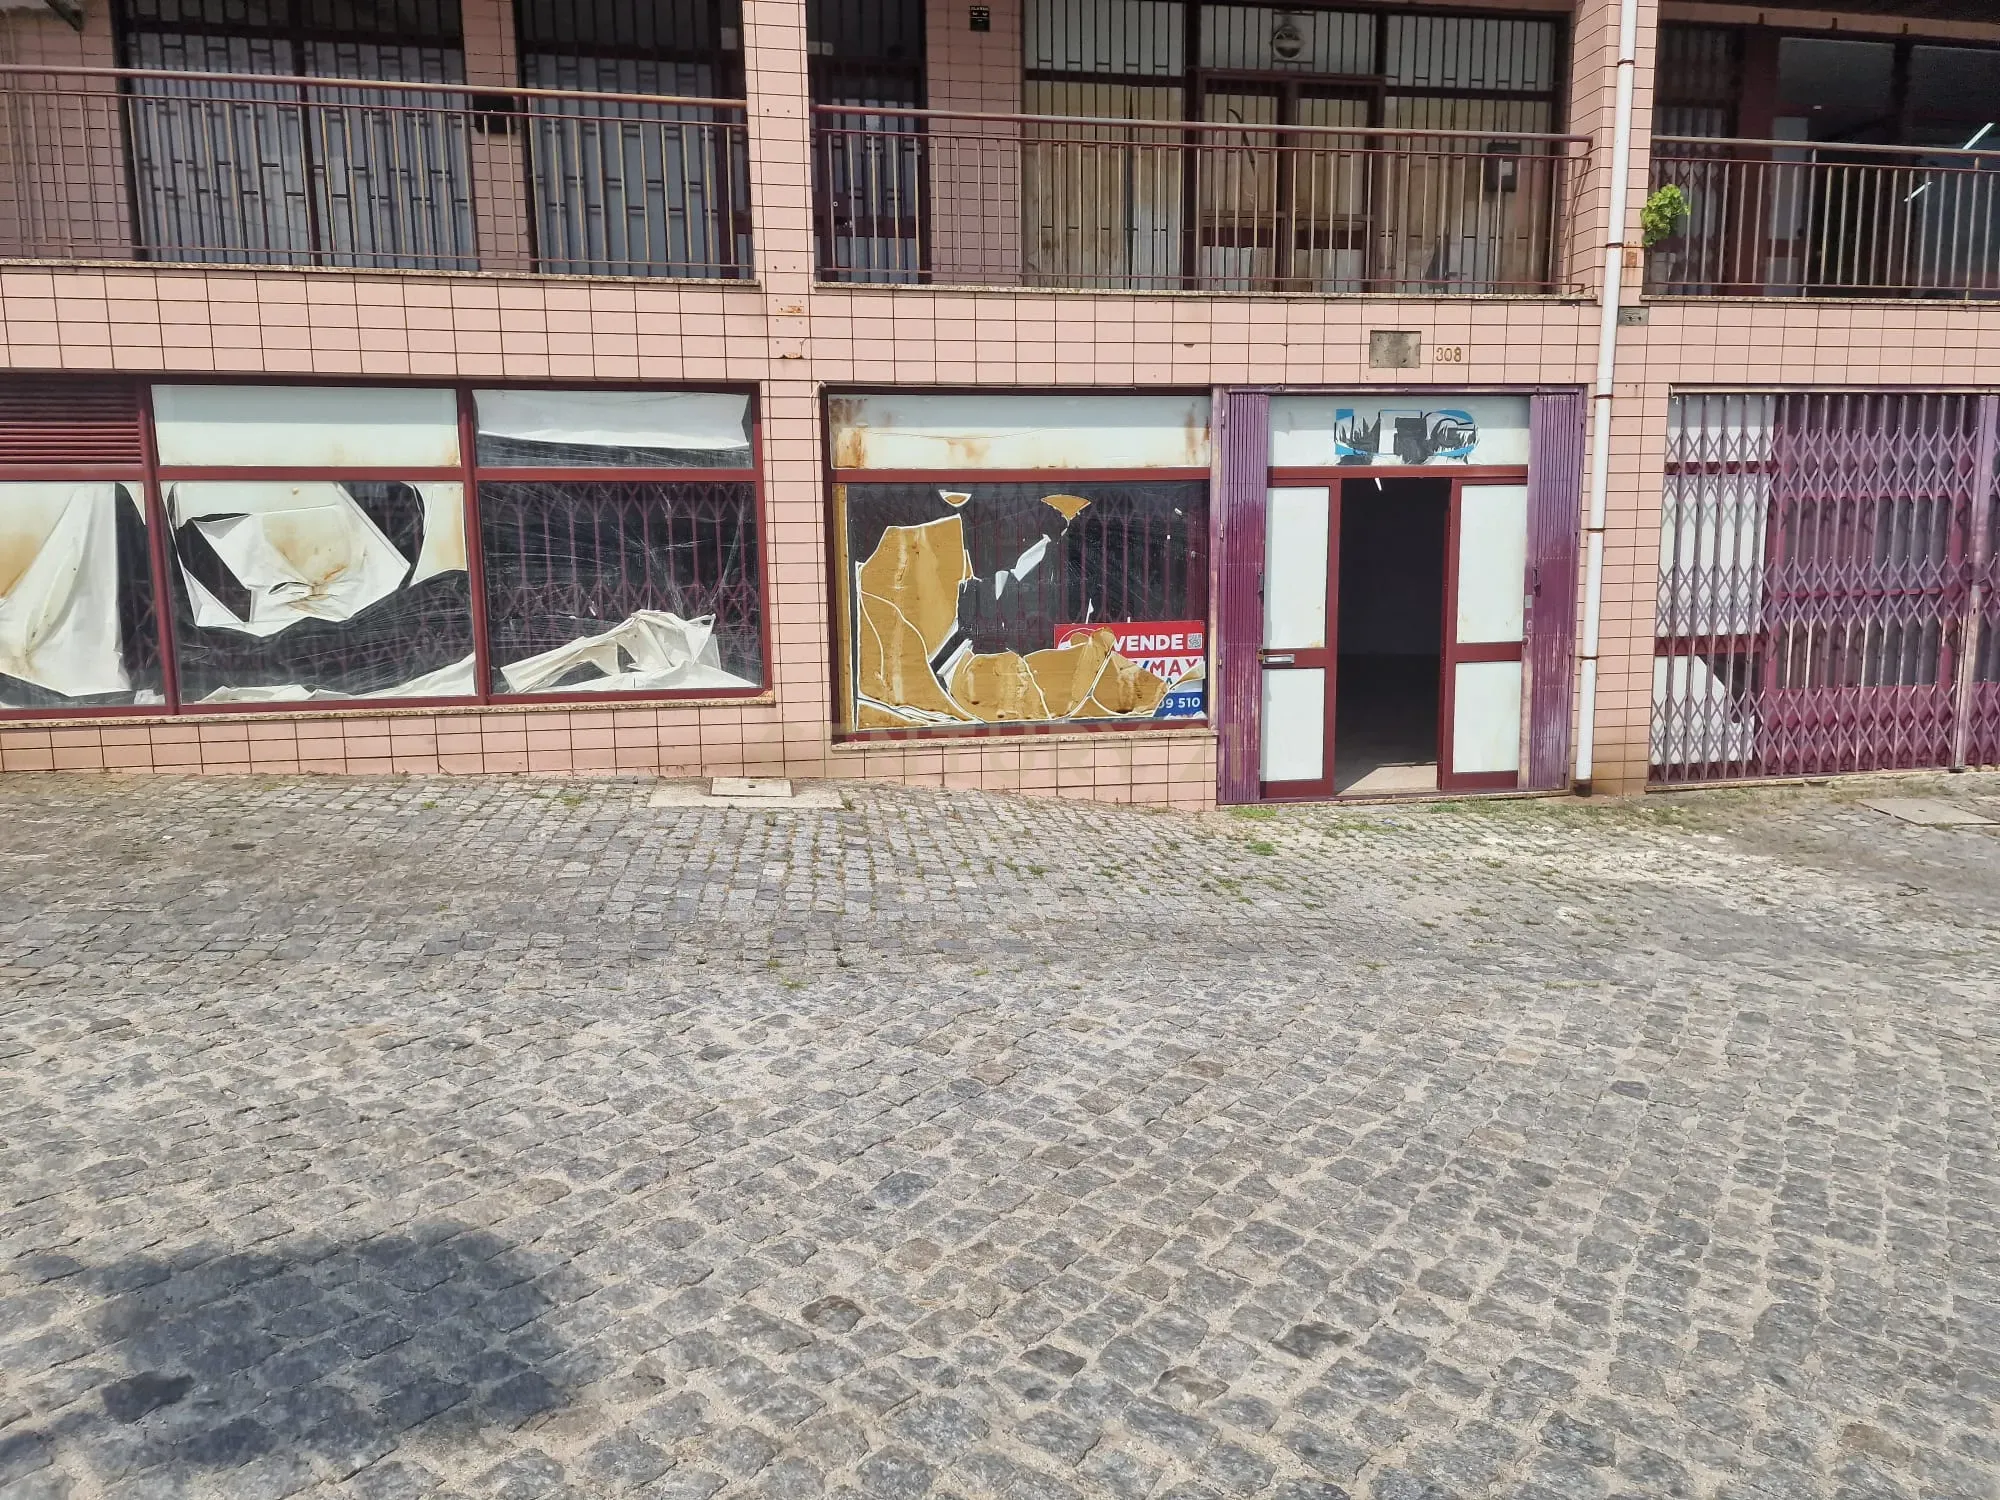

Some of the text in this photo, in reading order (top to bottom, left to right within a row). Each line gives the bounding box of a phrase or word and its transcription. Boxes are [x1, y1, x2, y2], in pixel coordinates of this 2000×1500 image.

[1436, 347, 1461, 362] 308
[1113, 634, 1183, 652] VENDE
[1178, 697, 1201, 709] 510
